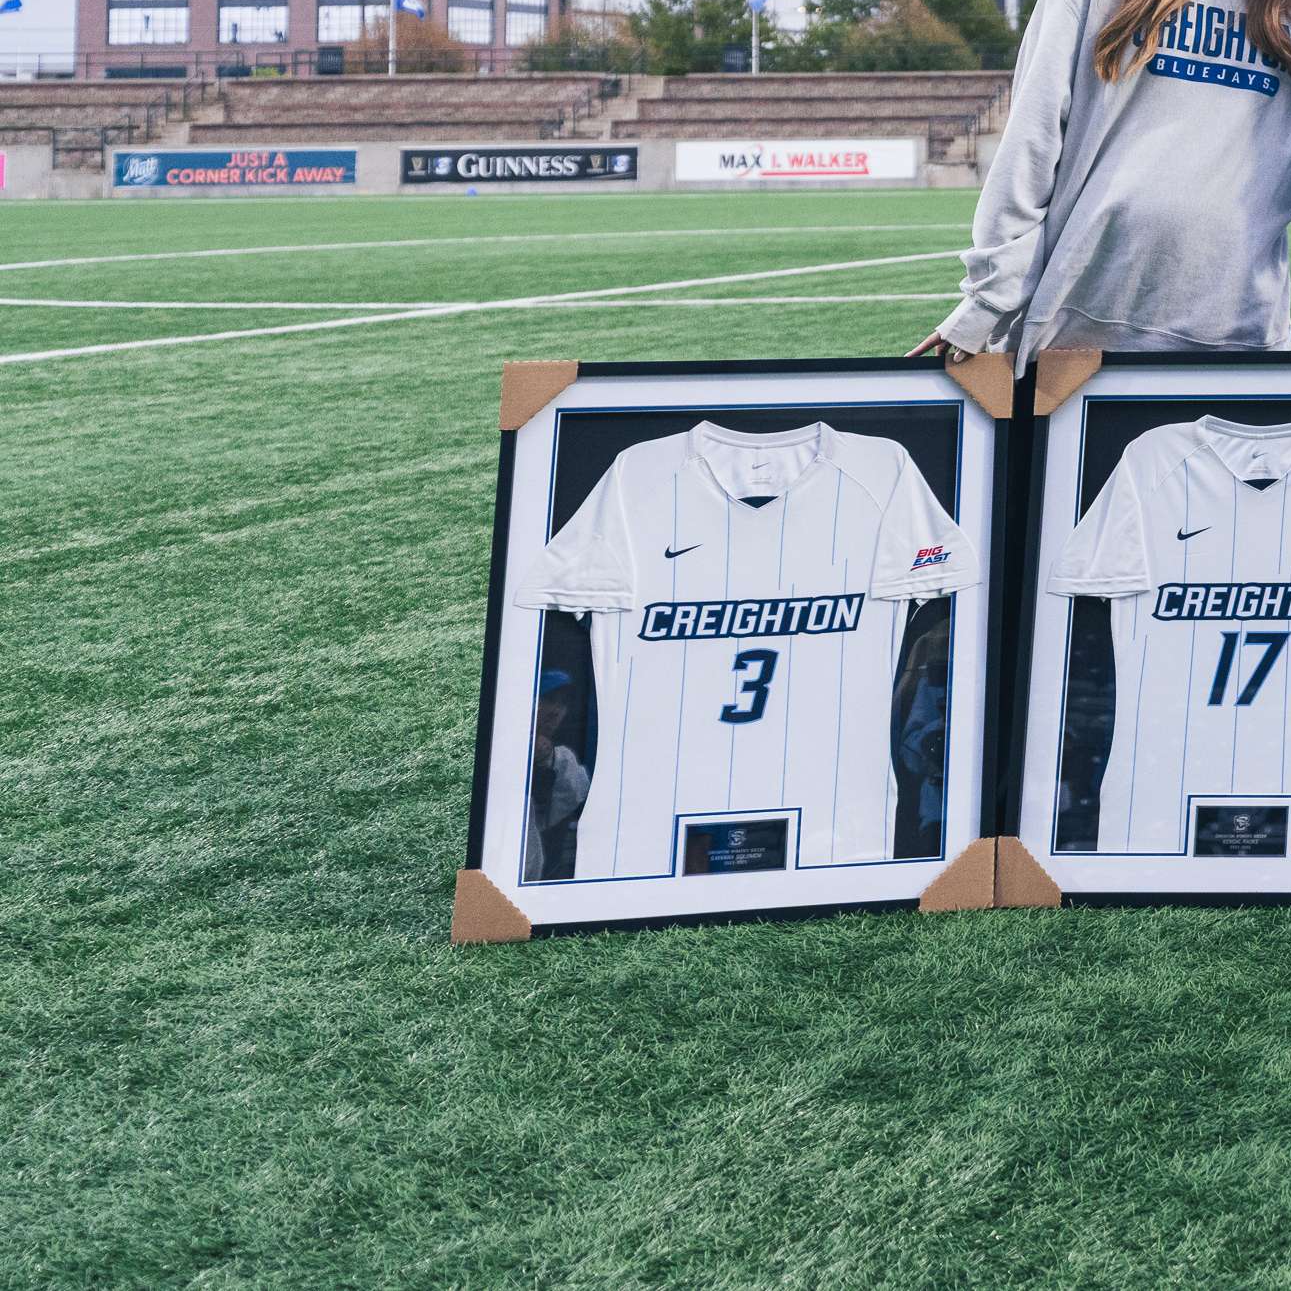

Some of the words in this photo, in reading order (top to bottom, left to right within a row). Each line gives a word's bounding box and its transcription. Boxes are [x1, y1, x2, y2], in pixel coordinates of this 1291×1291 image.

[1156, 58, 1271, 90] BLUEJAYS
[226, 152, 270, 167] JUST
[272, 152, 288, 167] A
[456, 153, 579, 178] GUINNESS
[719, 153, 763, 169] MAX
[788, 152, 869, 169] WALKER
[166, 167, 241, 184] CORNER
[245, 167, 288, 183] KICK
[293, 167, 346, 183] AWAY
[912, 552, 952, 566] EAST
[917, 545, 944, 558] BIG
[639, 593, 866, 641] CREIGHTON
[1207, 631, 1291, 707] 17
[719, 648, 779, 724] 3
